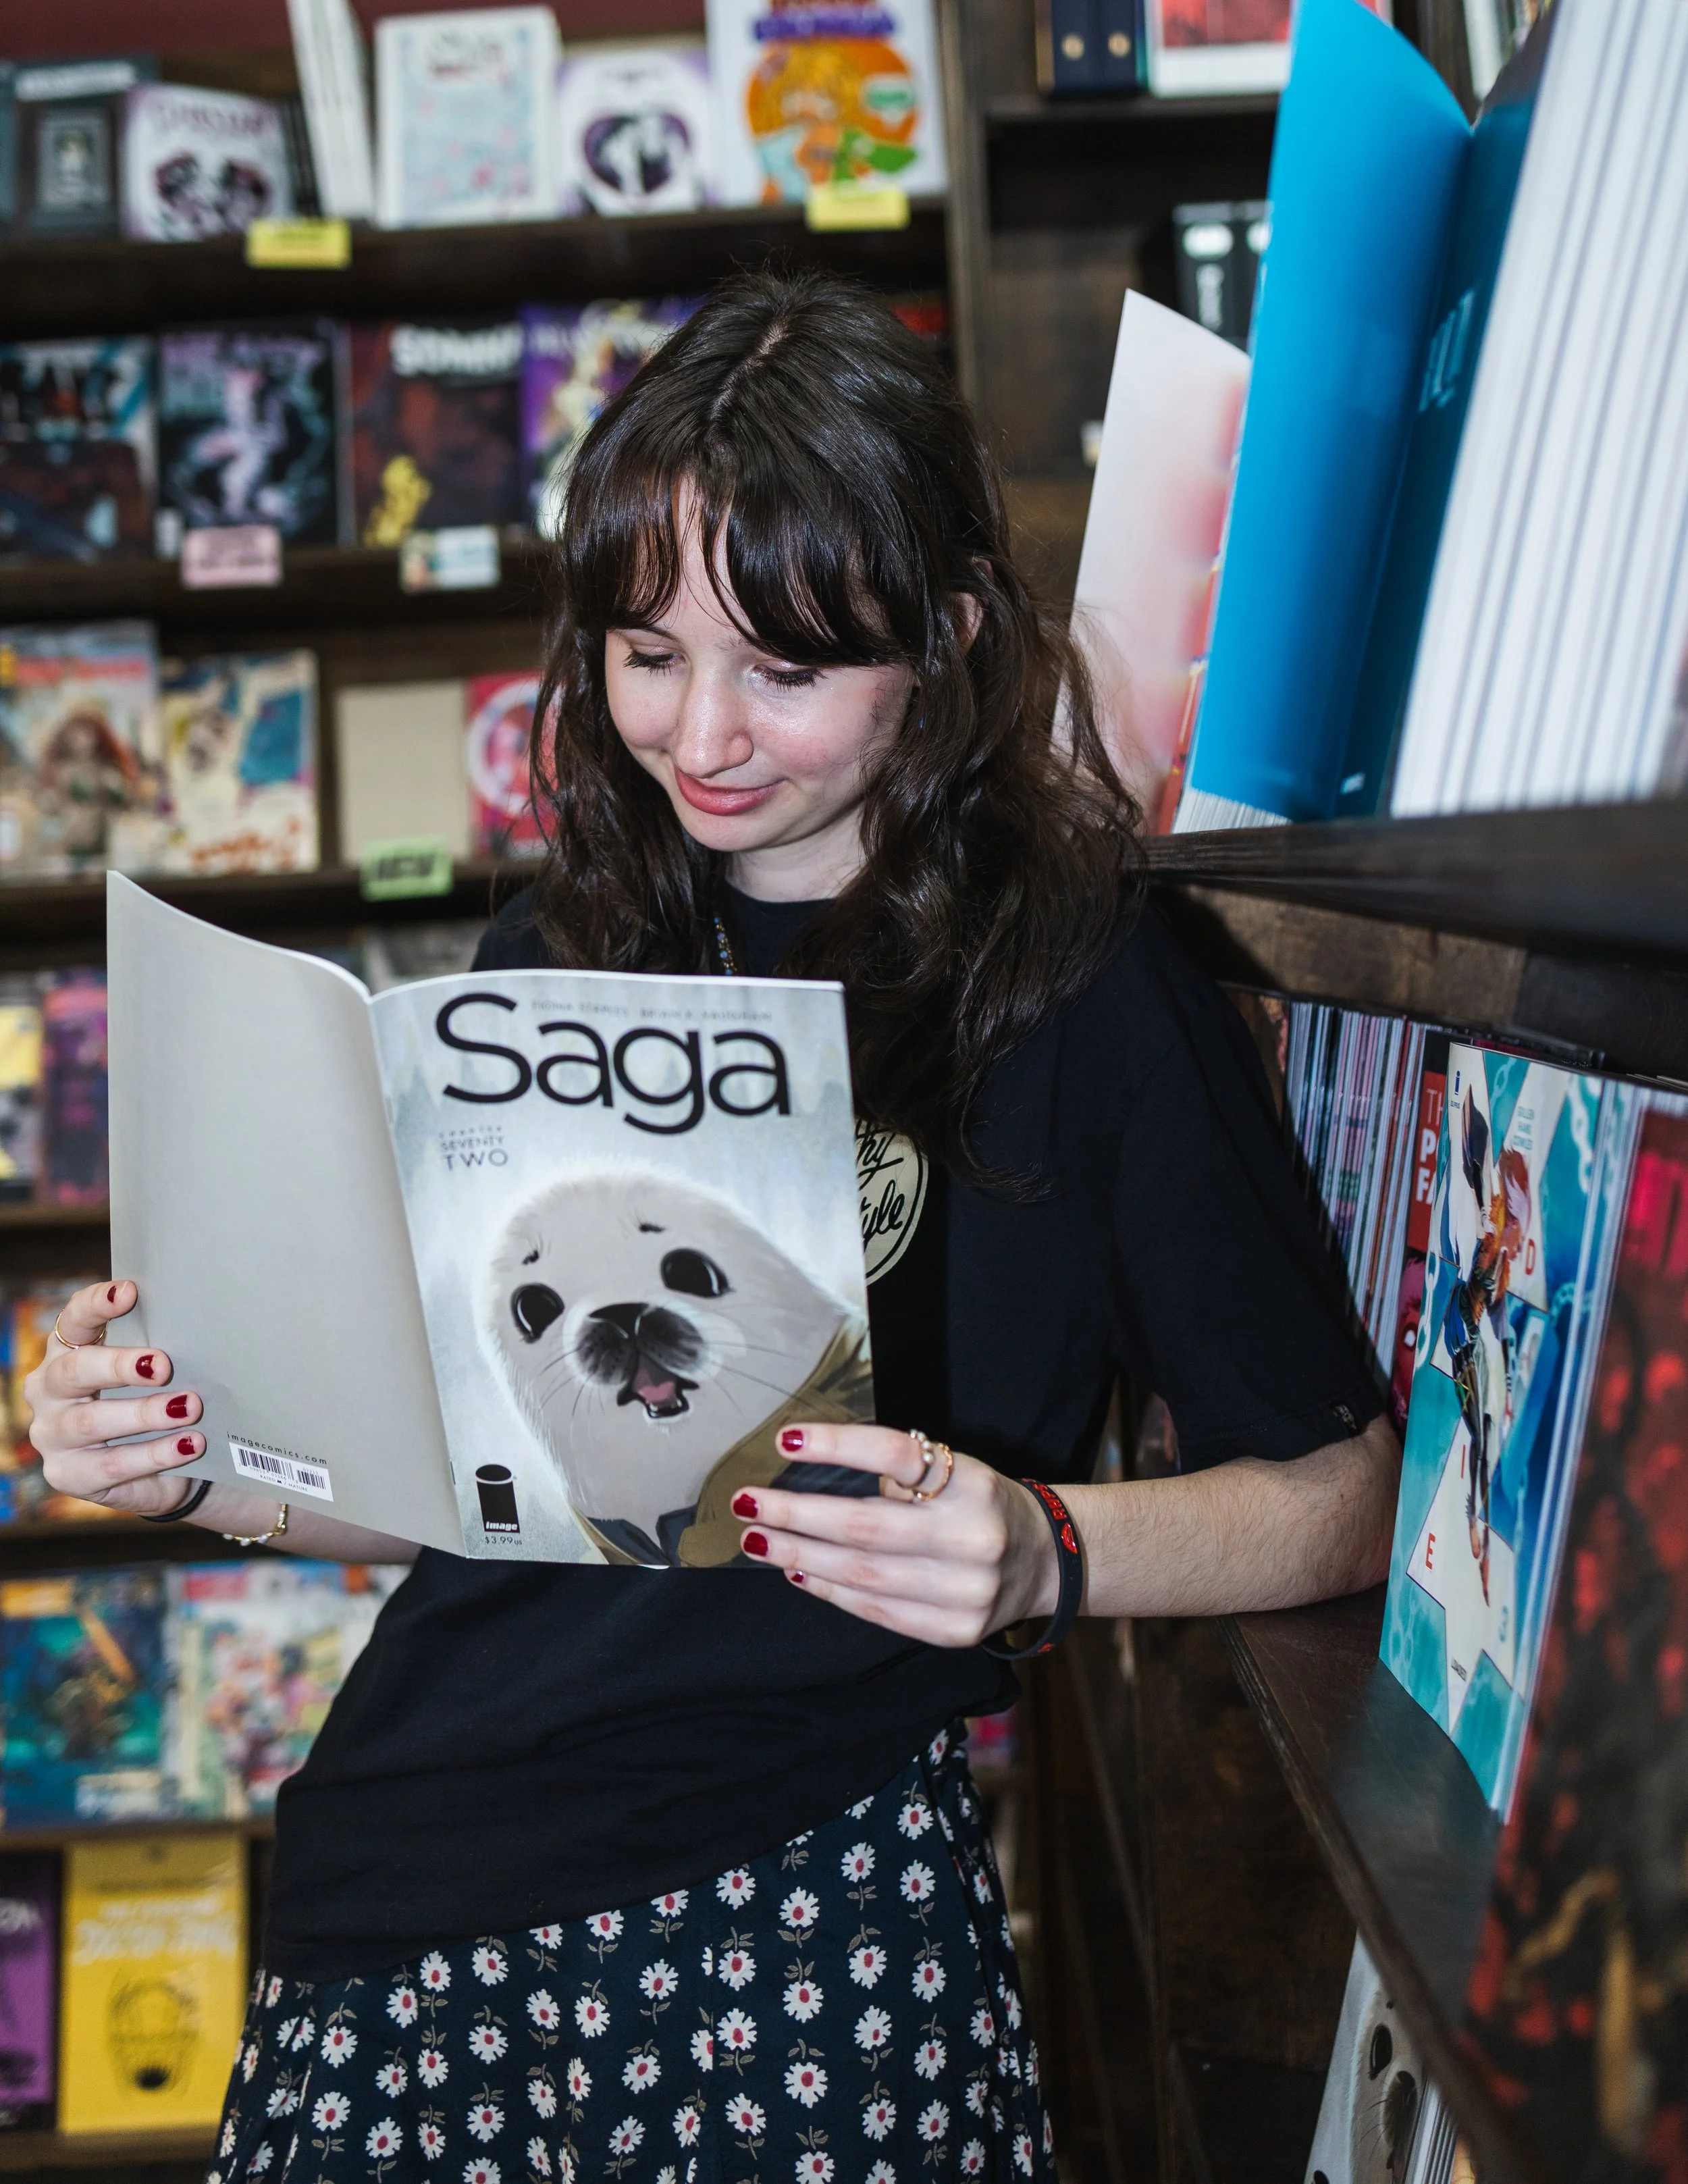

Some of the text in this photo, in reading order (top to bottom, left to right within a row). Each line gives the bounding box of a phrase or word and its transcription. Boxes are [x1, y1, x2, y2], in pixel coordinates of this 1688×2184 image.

[436, 991, 791, 1135] Saga
[440, 1135, 505, 1153] SEVENTY
[442, 1147, 508, 1171] TWO
[227, 1432, 327, 1465] imagecomics.com
[486, 1521, 518, 1531] image
